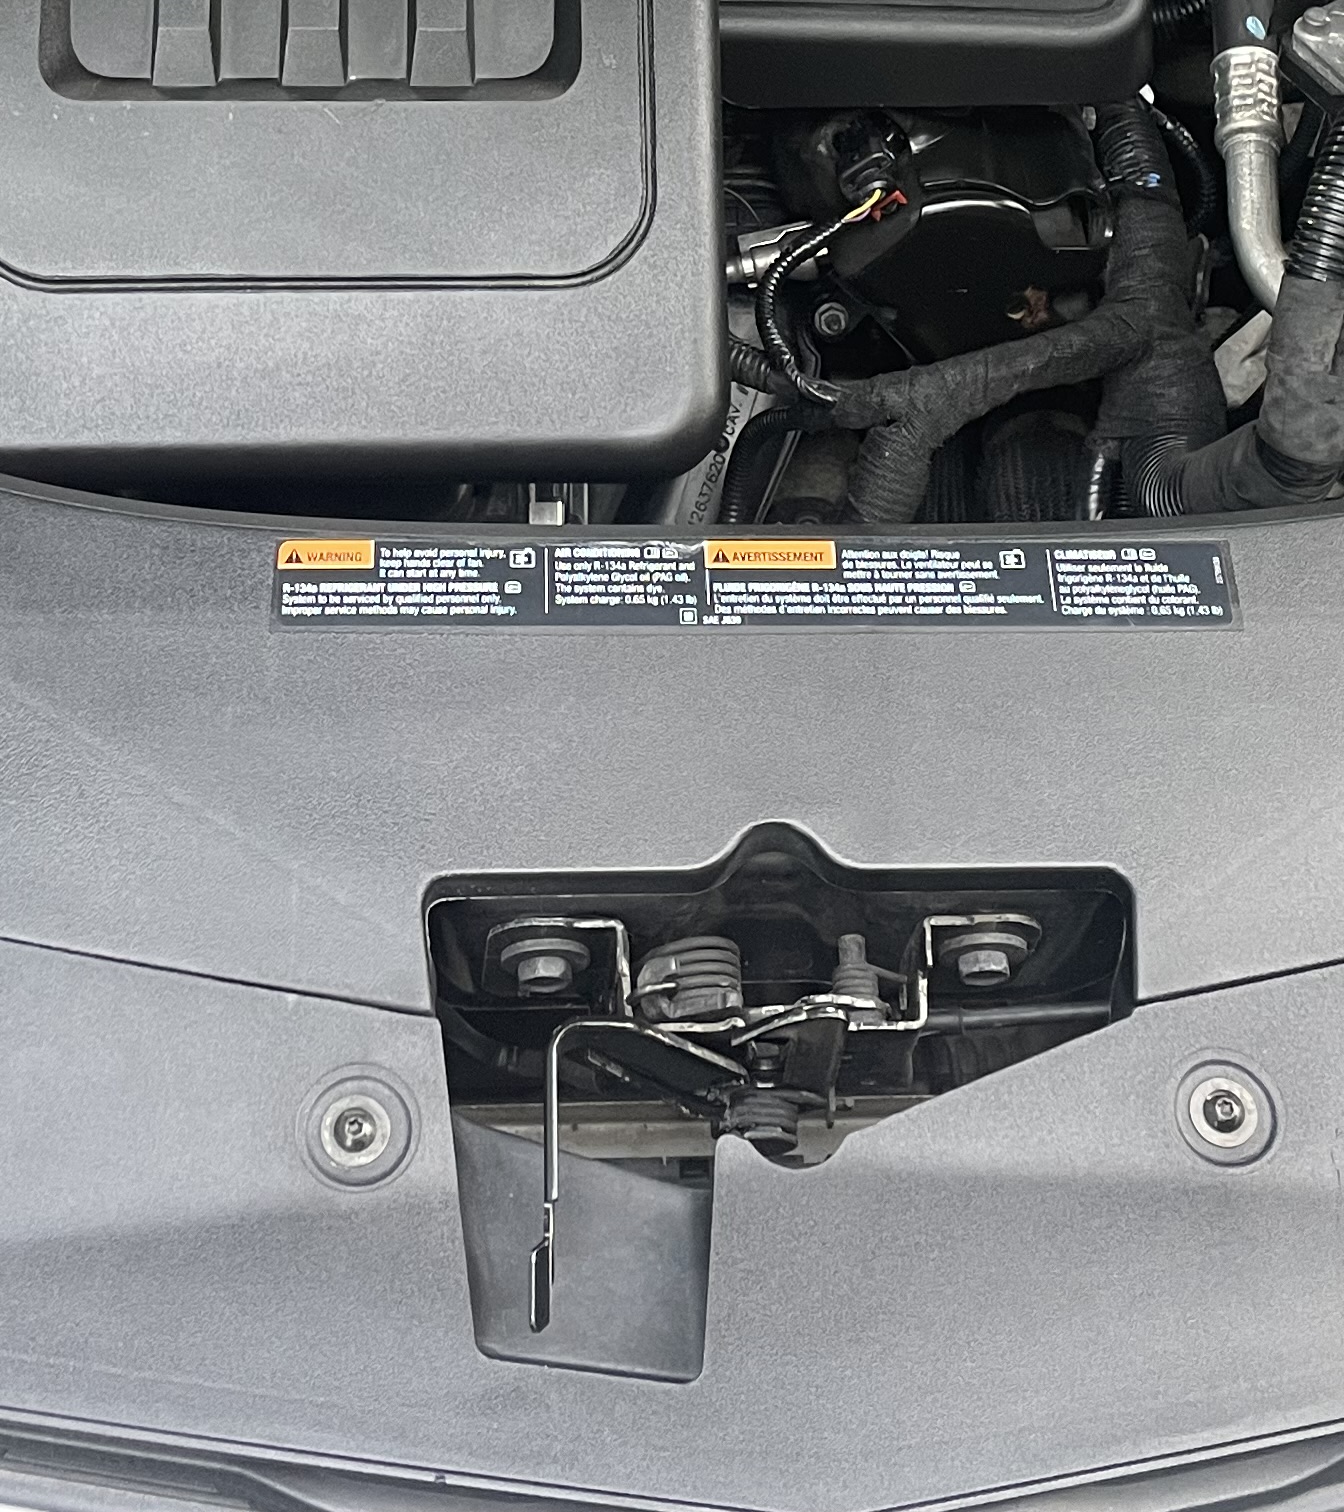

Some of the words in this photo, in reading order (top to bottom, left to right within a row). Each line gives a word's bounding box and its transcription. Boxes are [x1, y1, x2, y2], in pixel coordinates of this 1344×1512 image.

[306, 552, 362, 562] WARNING
[380, 548, 391, 557] To
[393, 548, 412, 559] help
[414, 548, 438, 557] avoid
[440, 548, 477, 559] personal
[732, 552, 824, 562] AVERTISSEMENT
[555, 561, 571, 570] Use
[573, 561, 592, 572] only
[593, 561, 626, 570] R-134a
[629, 561, 676, 572] Refrigerant
[678, 561, 695, 570] and
[555, 583, 572, 593] The
[573, 584, 606, 595] system
[607, 584, 644, 593] contains
[646, 584, 665, 594] dye.
[555, 594, 588, 606] System
[625, 595, 645, 604] 0.65
[647, 595, 658, 606] kg
[661, 595, 684, 605] (1.43
[685, 595, 697, 605] lb)
